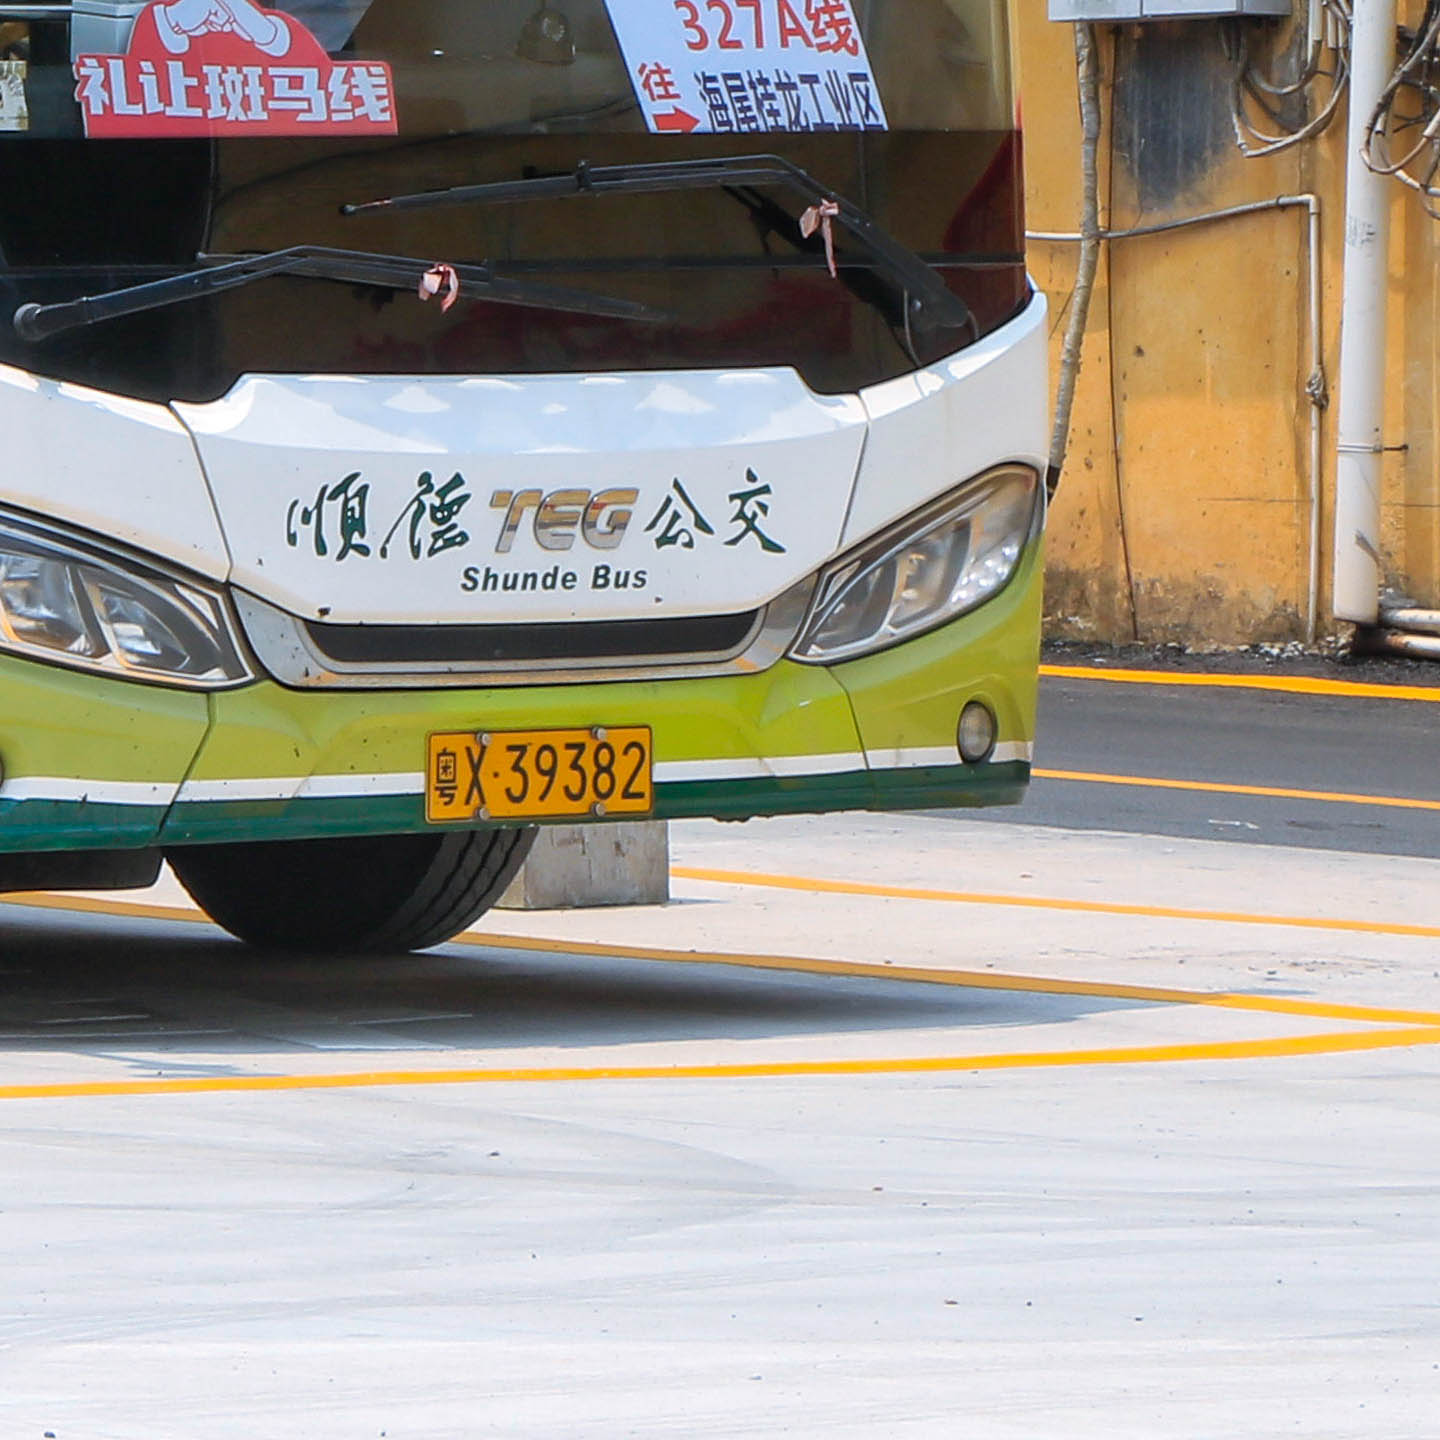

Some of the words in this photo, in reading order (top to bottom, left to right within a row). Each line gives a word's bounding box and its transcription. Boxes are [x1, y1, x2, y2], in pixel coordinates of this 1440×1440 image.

[77, 56, 392, 122] 礼让斑马线
[636, 61, 682, 103] 往
[488, 486, 642, 554] TEG
[644, 466, 788, 555] 公交
[459, 564, 579, 593] Shunde
[591, 565, 649, 591] Bus
